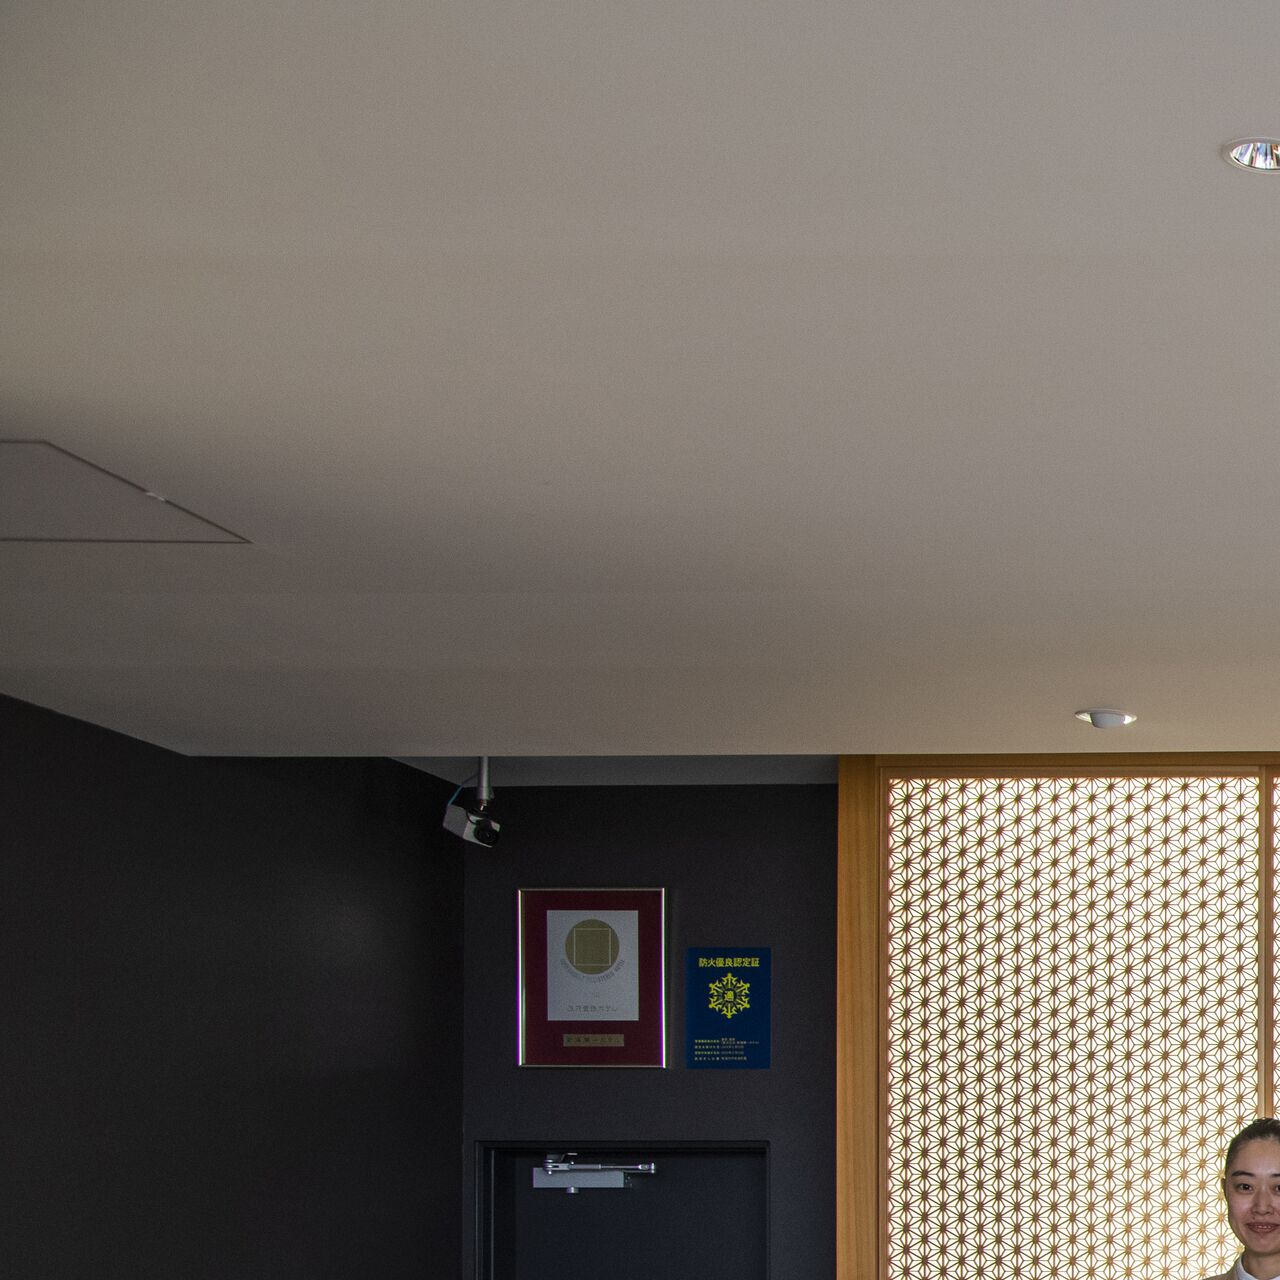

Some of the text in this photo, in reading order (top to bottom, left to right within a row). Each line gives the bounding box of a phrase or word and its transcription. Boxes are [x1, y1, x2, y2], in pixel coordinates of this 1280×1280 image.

[699, 957, 760, 968] 防火優良認定証
